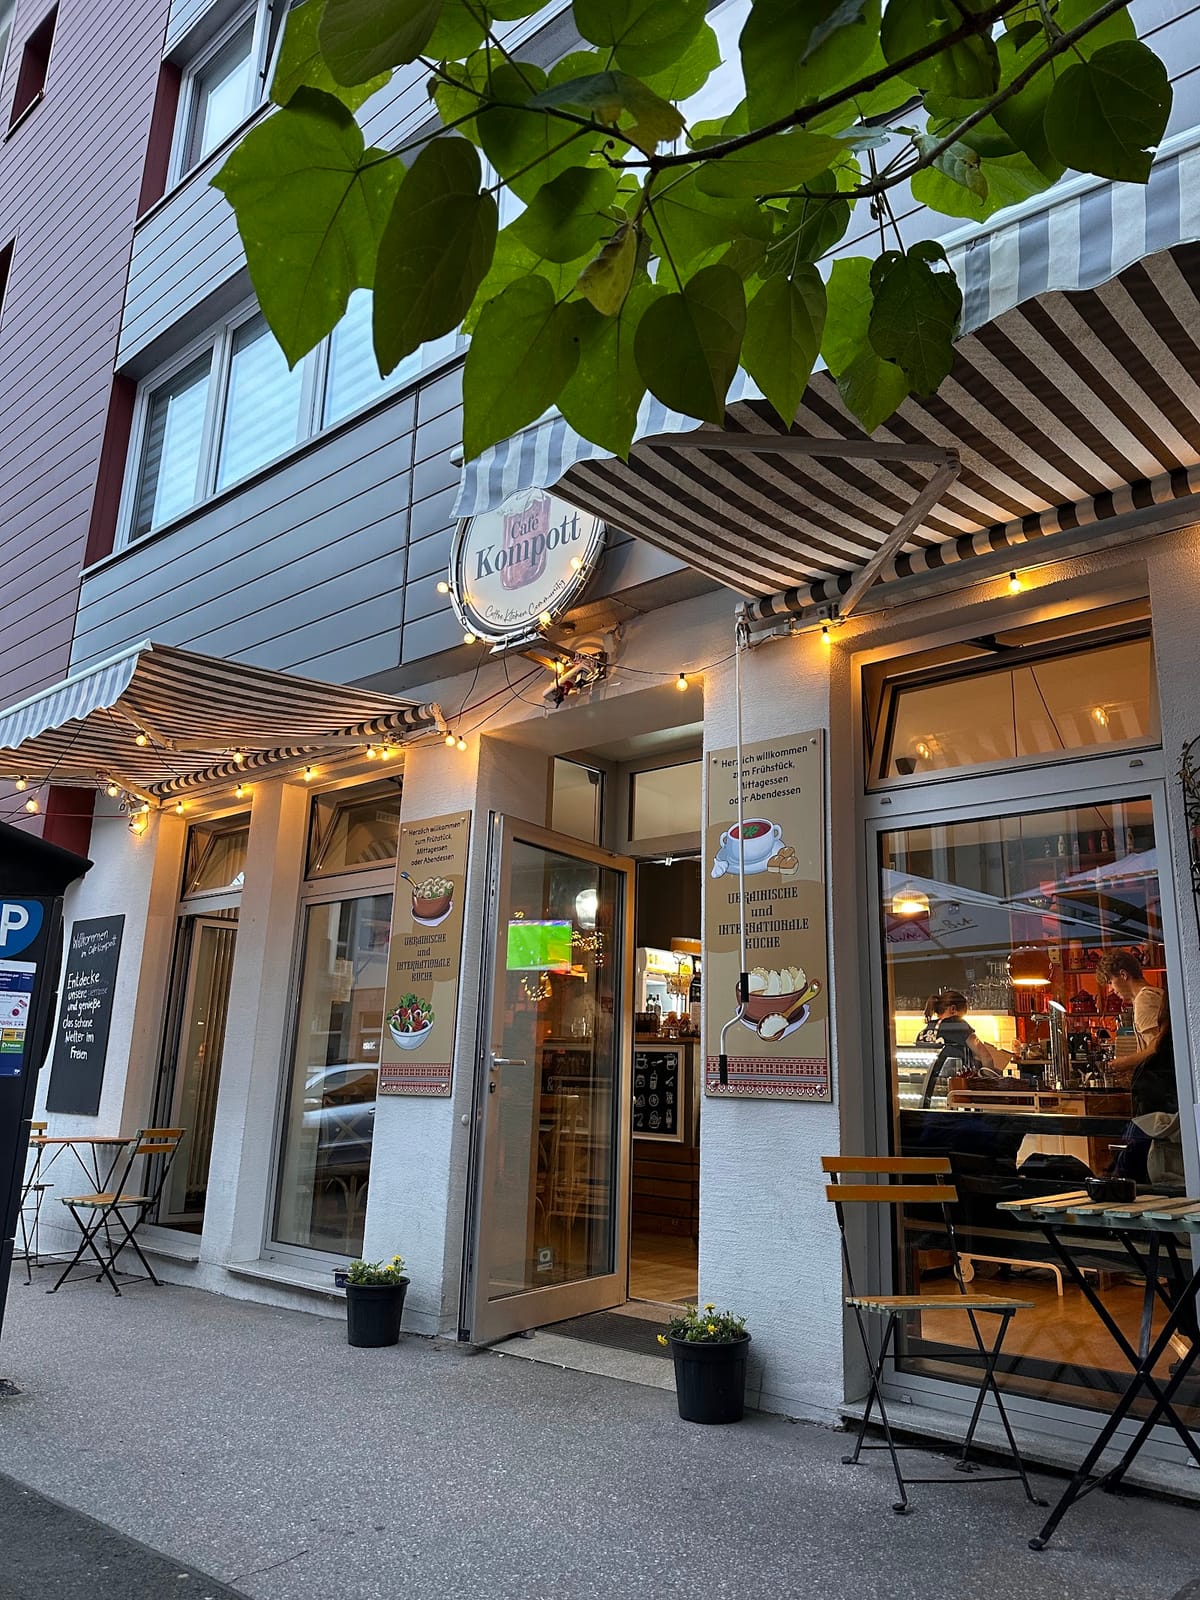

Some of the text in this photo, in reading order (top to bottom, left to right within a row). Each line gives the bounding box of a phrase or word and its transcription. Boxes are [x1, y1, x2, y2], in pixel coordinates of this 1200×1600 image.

[511, 513, 539, 539] Café
[474, 511, 582, 581] Kompott
[756, 745, 808, 761] willkommen
[750, 787, 801, 802] Abendessen
[423, 854, 455, 864] Abendessen
[751, 905, 773, 917] und
[1, 904, 29, 946] P
[72, 930, 109, 949] Willkommen
[417, 947, 431, 957] und
[67, 969, 100, 990] Entdecke
[68, 989, 88, 1001] unsere
[67, 998, 101, 1017] und genieße
[62, 1014, 74, 1029] das
[65, 1030, 95, 1044] Wetter im
[70, 1046, 88, 1060] Freien
